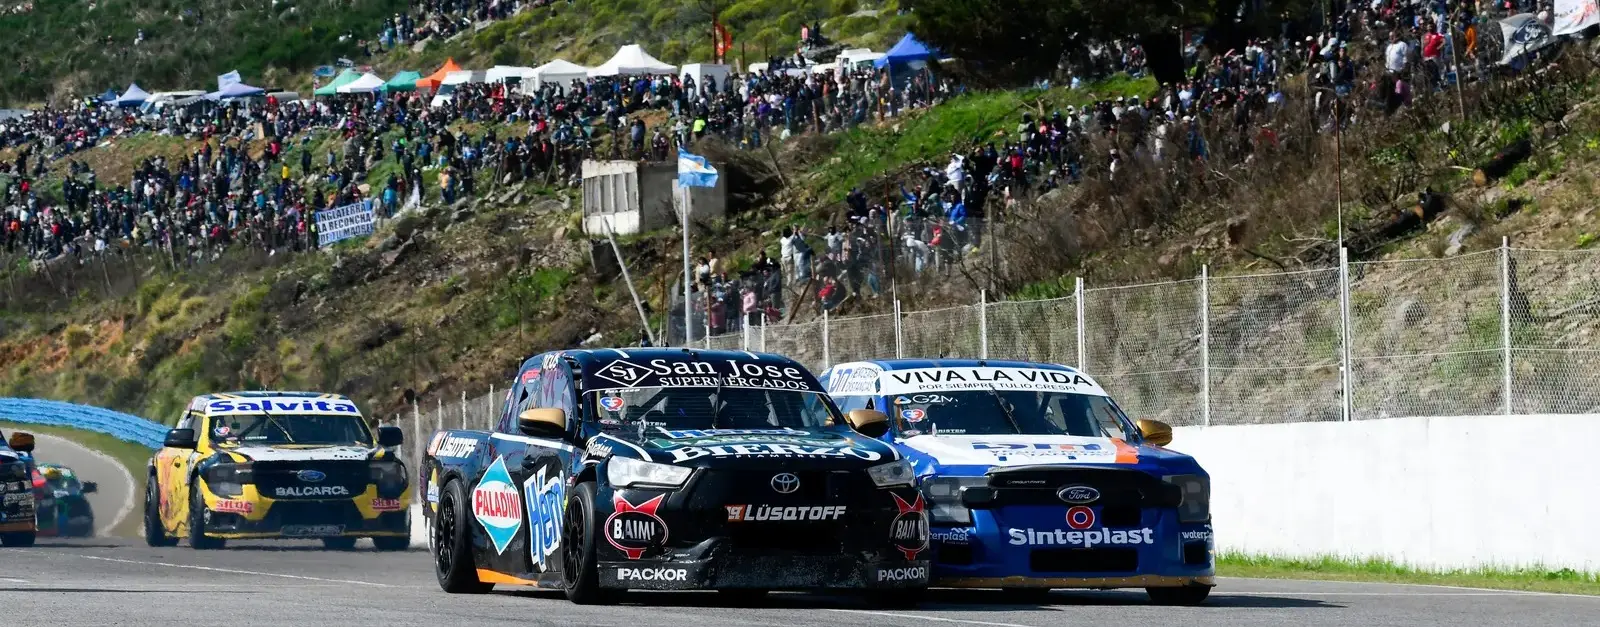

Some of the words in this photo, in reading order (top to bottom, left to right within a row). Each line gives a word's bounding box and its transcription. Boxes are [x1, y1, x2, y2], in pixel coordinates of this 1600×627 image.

[318, 203, 366, 222] INGLATERRA
[317, 223, 328, 233] LA
[328, 212, 371, 231] RECONCHA
[609, 365, 637, 380] SJ
[650, 359, 717, 375] San
[726, 359, 803, 379] Jose
[660, 376, 810, 390] SUPERMERCADOS
[892, 370, 966, 384] VIVA
[972, 370, 1013, 381] LA
[1018, 371, 1093, 387] VIDA
[210, 400, 356, 412] Salvita
[665, 443, 882, 463] BIERZO
[275, 486, 349, 496] BALCARCE
[475, 489, 520, 520] PALADINI
[744, 504, 847, 520] LÜSQTOFF
[1008, 527, 1154, 548] Sinteplast
[617, 567, 687, 581] PACKOR
[877, 567, 926, 581] PACKOR
